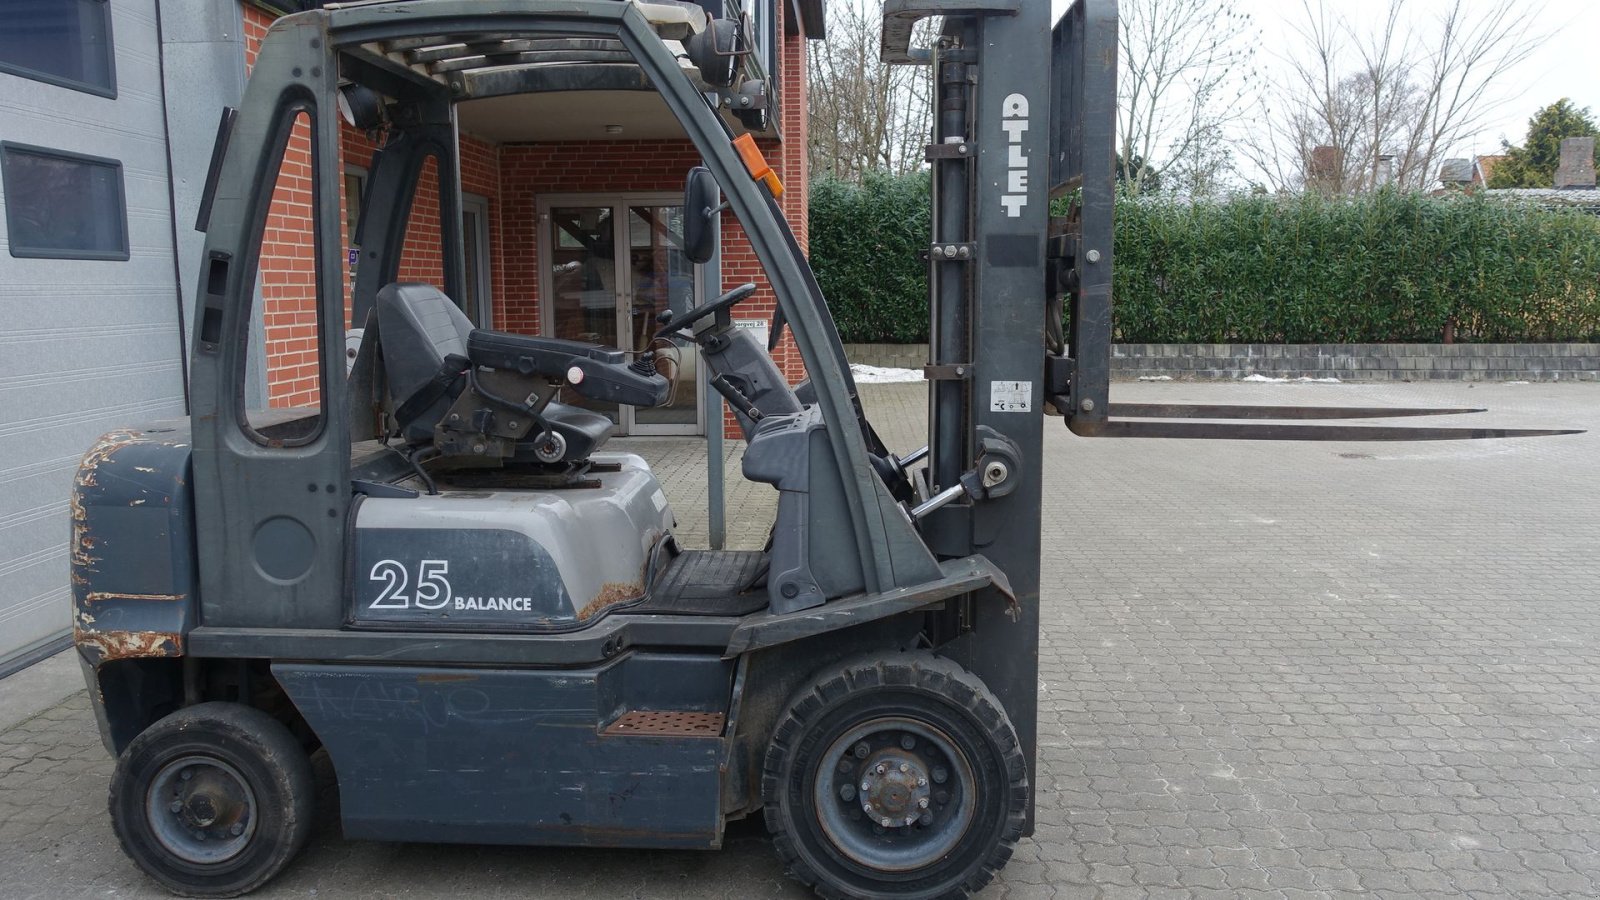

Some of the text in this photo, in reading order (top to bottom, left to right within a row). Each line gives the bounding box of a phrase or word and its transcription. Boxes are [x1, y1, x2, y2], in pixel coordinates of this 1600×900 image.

[1001, 93, 1029, 217] ATLET
[368, 559, 532, 611] 25 BALANCE
